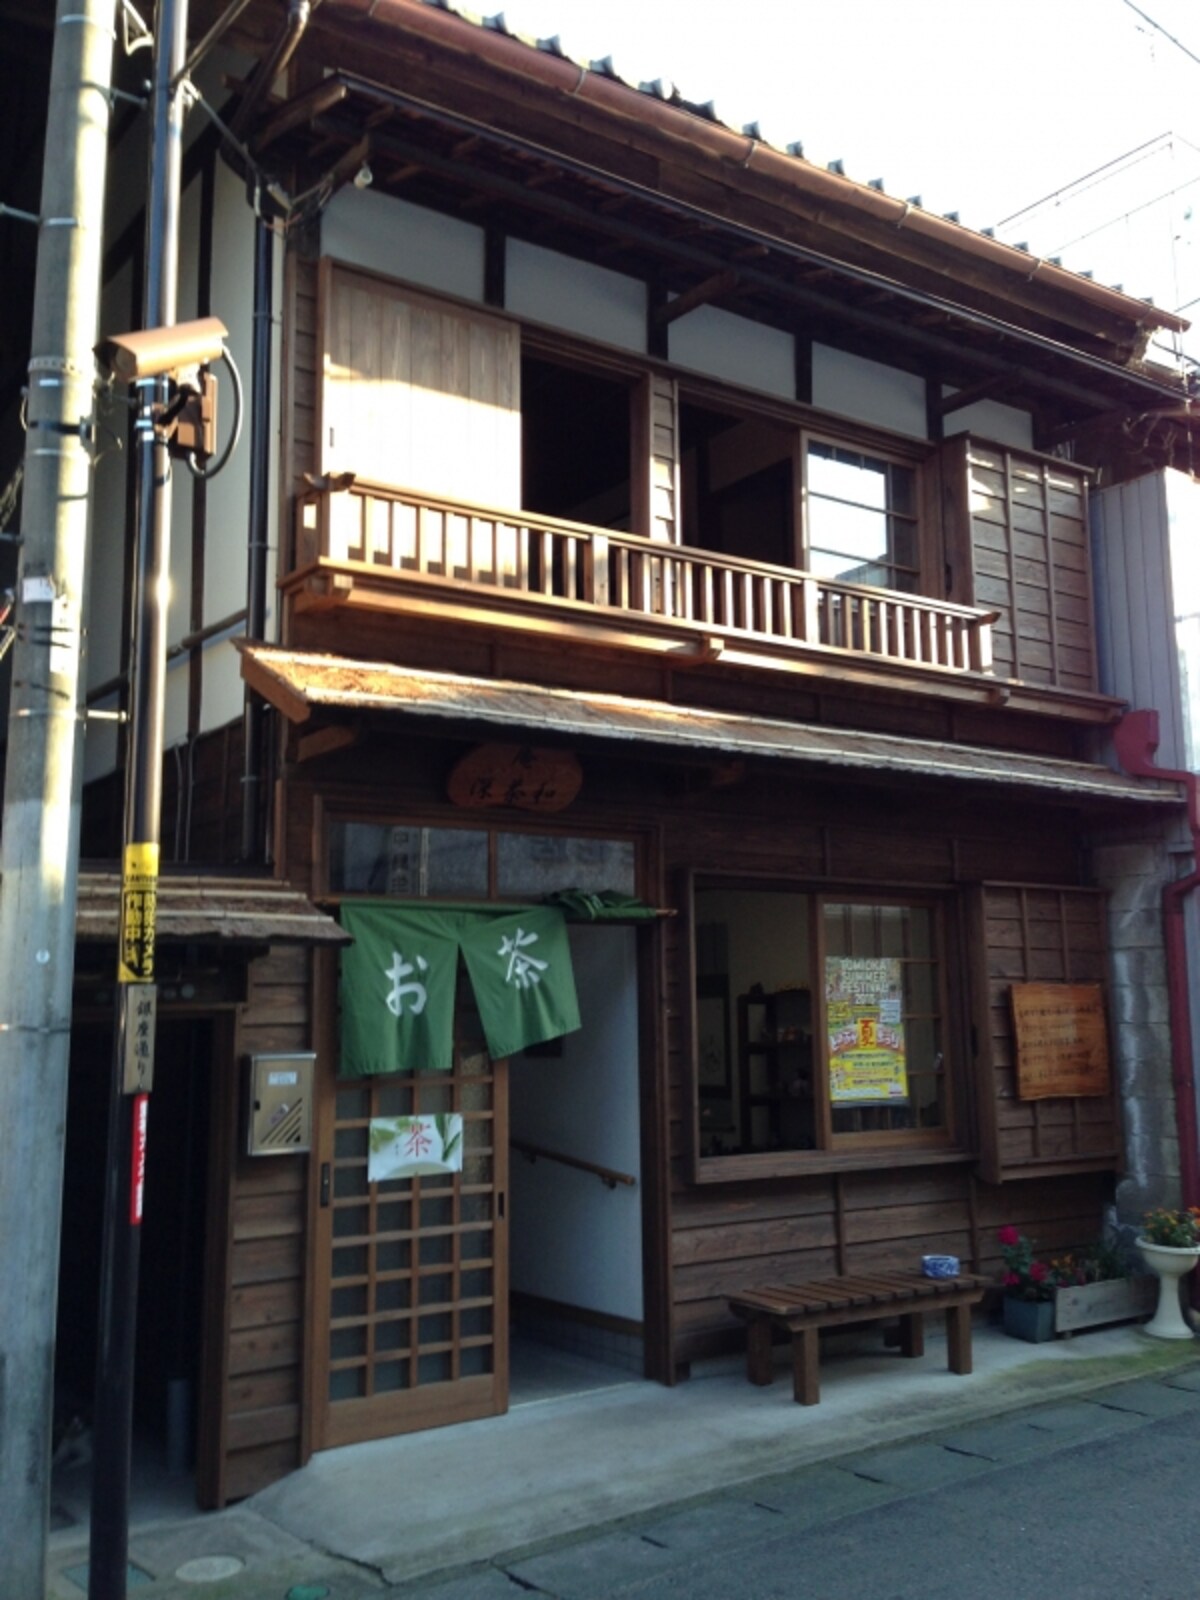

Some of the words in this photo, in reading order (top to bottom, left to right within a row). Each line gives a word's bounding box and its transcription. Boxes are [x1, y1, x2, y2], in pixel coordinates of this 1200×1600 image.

[841, 959, 887, 971] TOMIOKA
[842, 971, 887, 982] SUMMER
[841, 982, 889, 993] FESTIVAL
[403, 1122, 433, 1158] 茶
